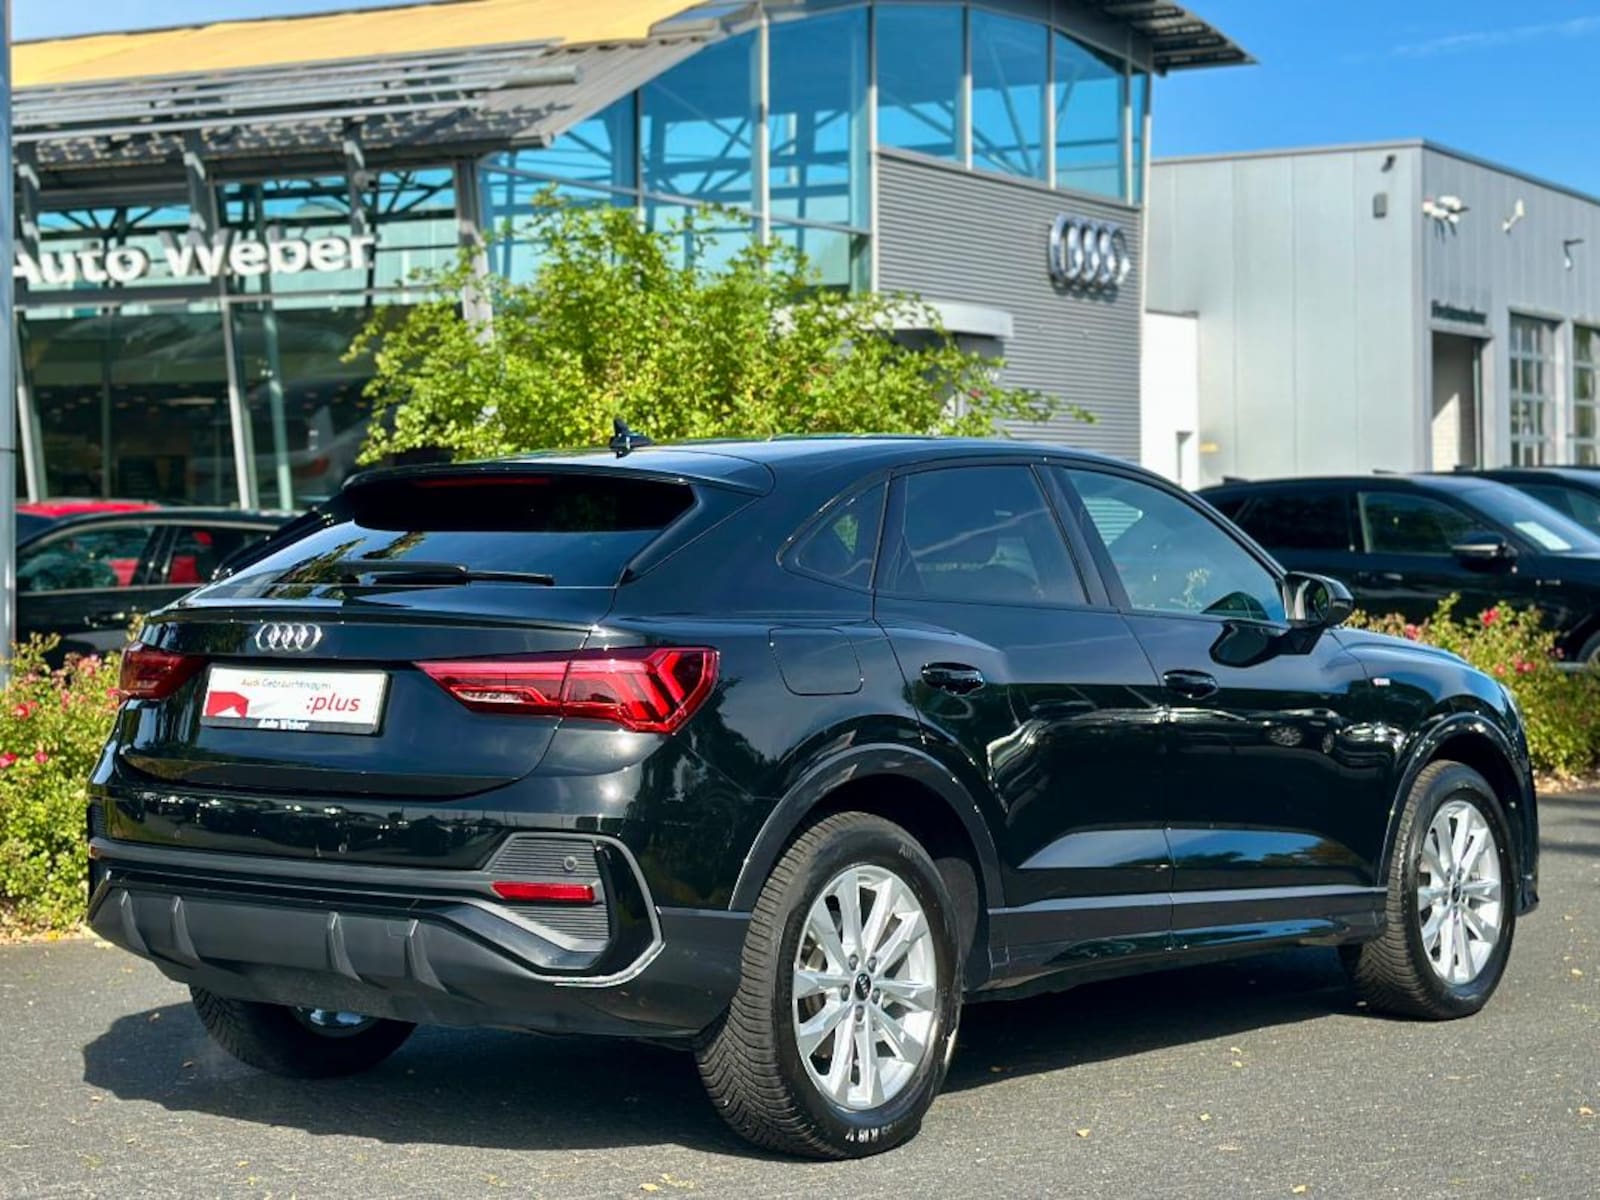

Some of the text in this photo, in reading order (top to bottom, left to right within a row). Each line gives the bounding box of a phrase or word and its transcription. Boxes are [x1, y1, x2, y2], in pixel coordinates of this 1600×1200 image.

[12, 228, 376, 285] Auto Weber
[240, 677, 260, 688] Audi
